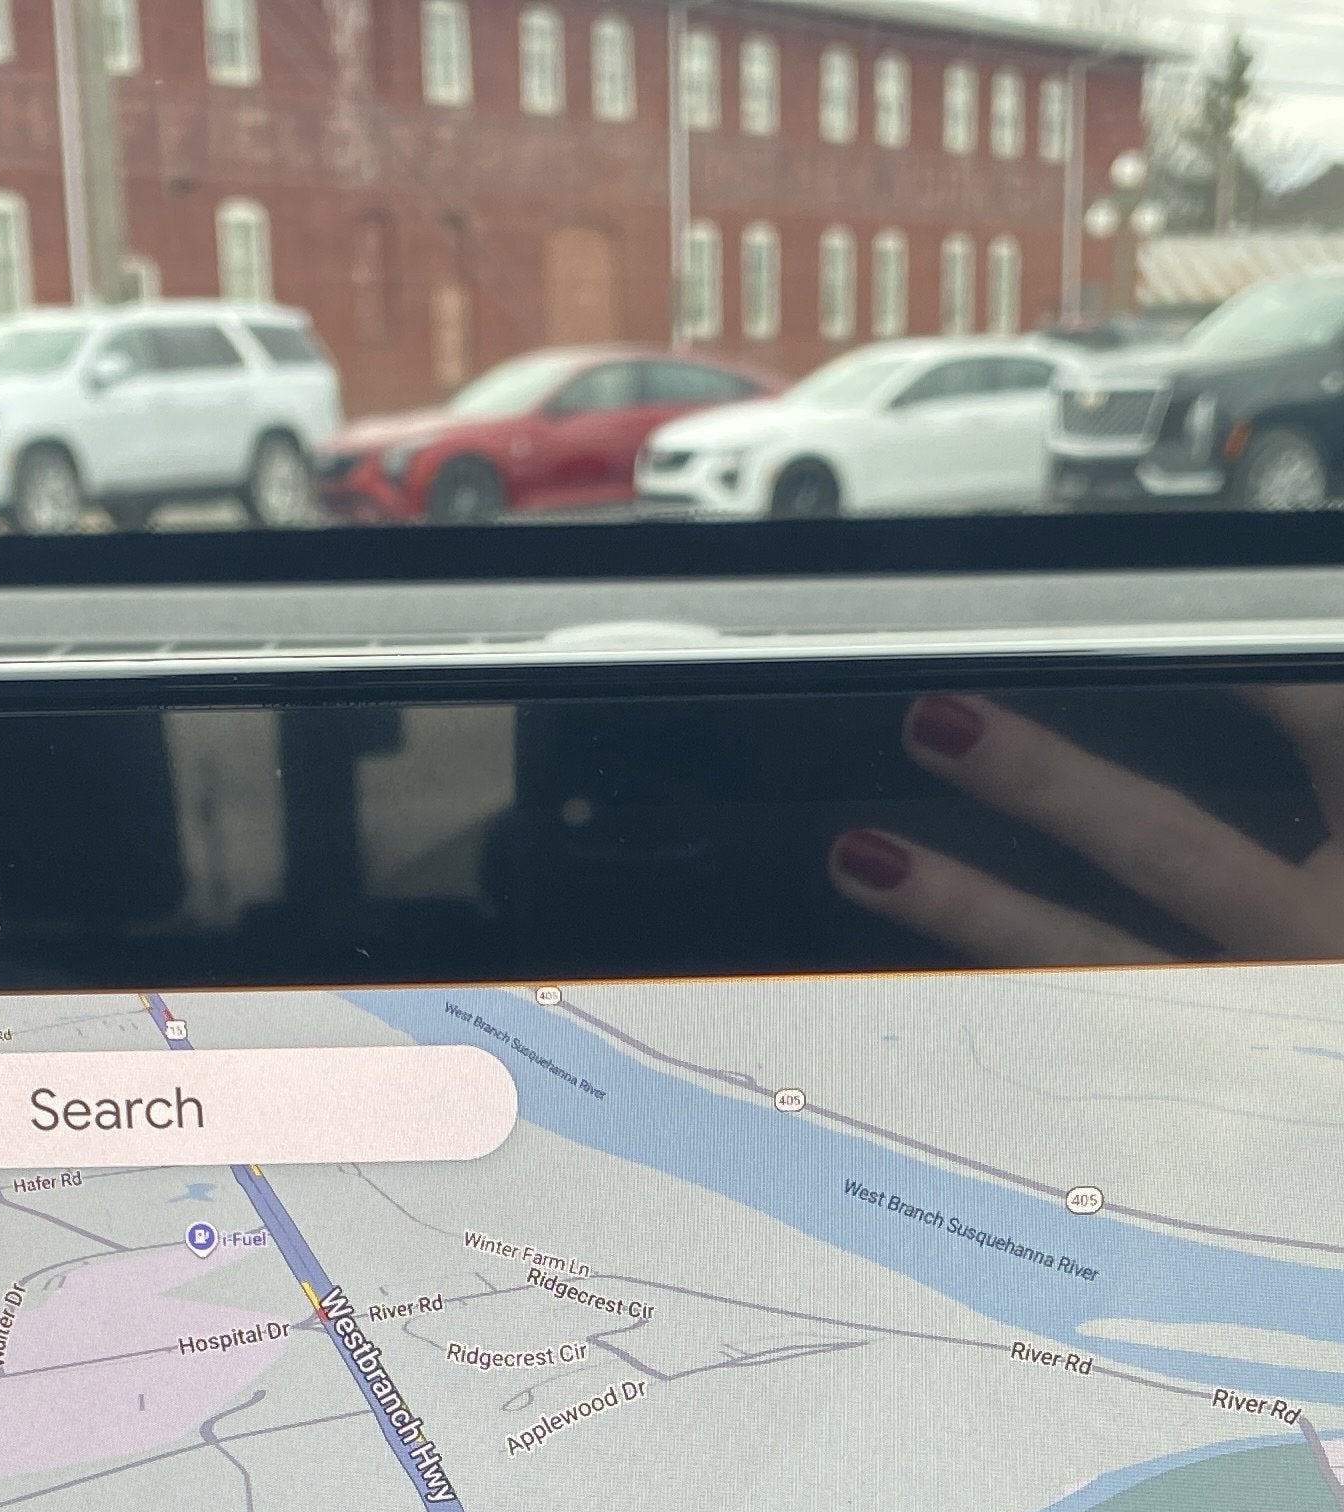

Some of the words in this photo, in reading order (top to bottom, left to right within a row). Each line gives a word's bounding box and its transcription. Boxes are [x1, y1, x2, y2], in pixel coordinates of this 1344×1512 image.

[445, 1001, 473, 1023] West
[473, 1015, 510, 1044] Branch
[511, 1037, 578, 1088] Susquehanna
[579, 1079, 607, 1101] River
[30, 1086, 205, 1131] Search
[778, 1094, 801, 1106] 405
[13, 1174, 57, 1194] Hafer
[60, 1171, 83, 1188] Rd
[1071, 1192, 1098, 1208] 405
[844, 1178, 885, 1207] West
[887, 1196, 944, 1230] Branch
[947, 1216, 1055, 1269] Susquehanna
[1057, 1257, 1100, 1283] River
[464, 1231, 518, 1260] Winter
[522, 1246, 565, 1271] Farm
[568, 1259, 590, 1277] Ln
[5, 1283, 27, 1309] Dr
[369, 1299, 414, 1322] River
[417, 1295, 444, 1313] Rd
[526, 1268, 624, 1316] Ridgecrest
[628, 1300, 655, 1320] Cir
[178, 1325, 262, 1355] Hospital
[265, 1322, 291, 1341] Dr
[446, 1343, 555, 1369] Ridgecrest
[559, 1342, 588, 1363] Cir
[1010, 1342, 1060, 1368] River
[1064, 1354, 1094, 1376] Rd
[320, 1287, 424, 1446] Westbranch
[410, 1441, 457, 1502] Hwy
[1212, 1389, 1267, 1414] River
[1271, 1401, 1302, 1425] Rd
[507, 1384, 618, 1456] Applewood
[621, 1380, 648, 1402] Dr
